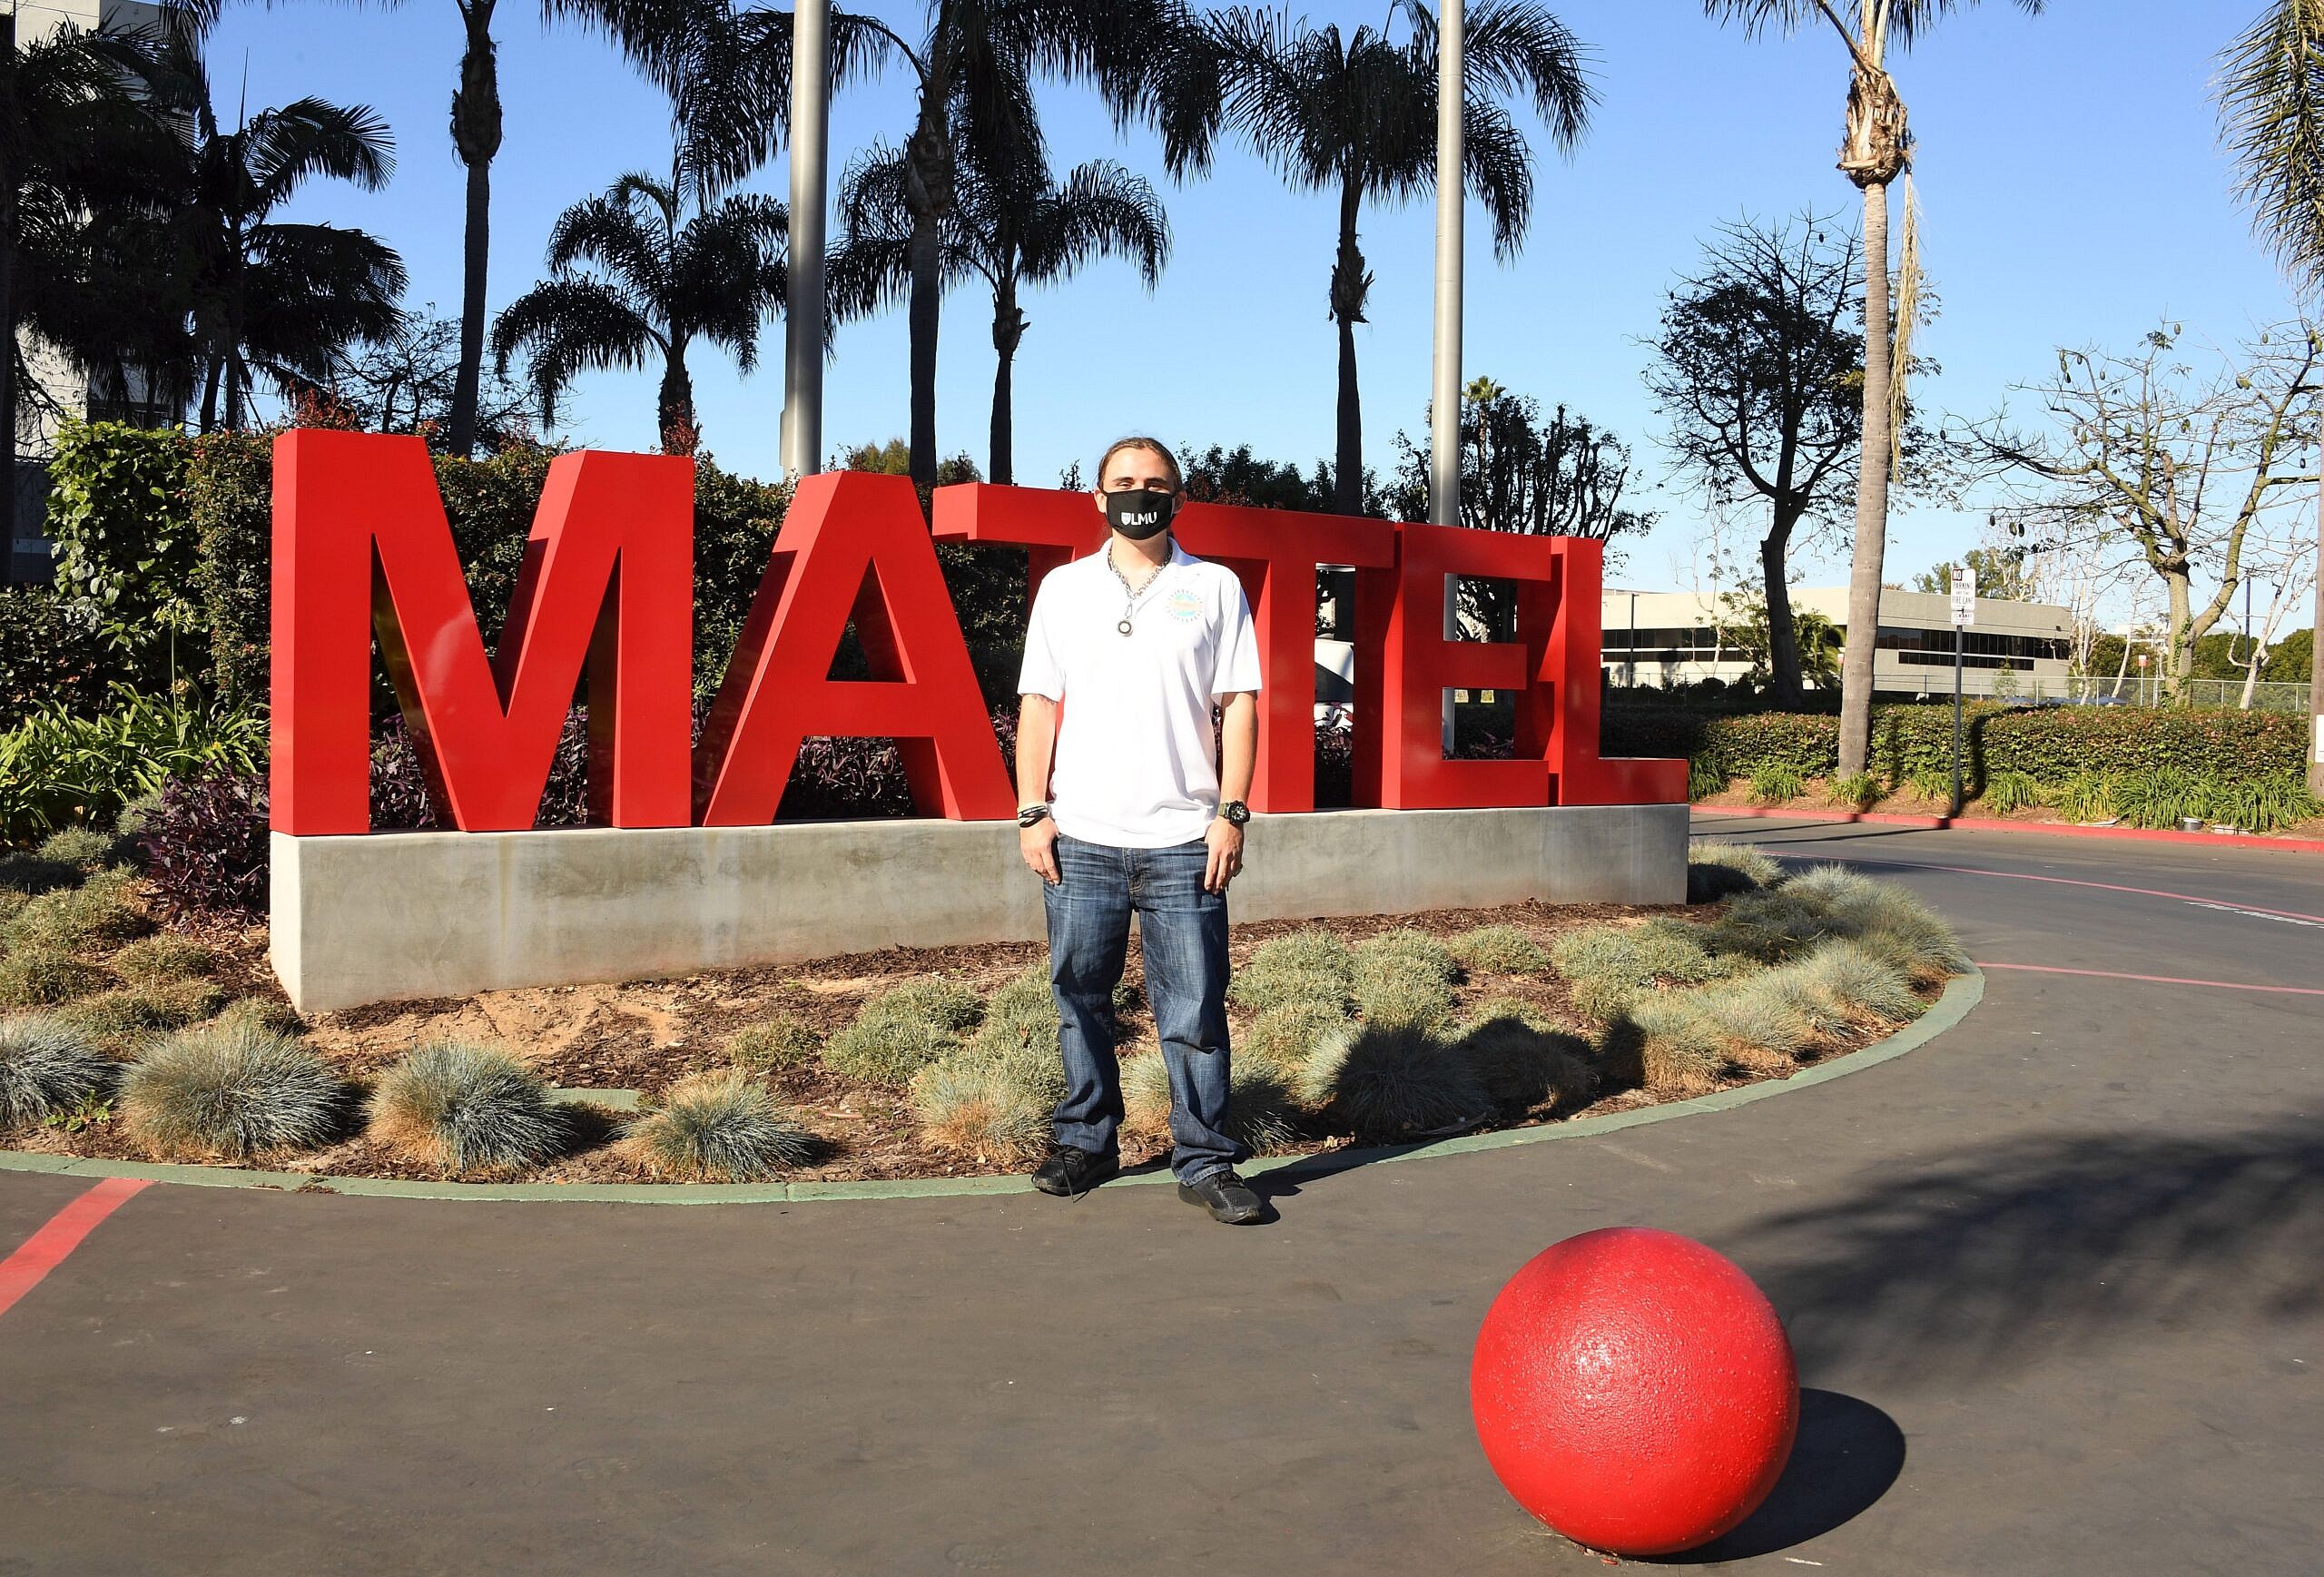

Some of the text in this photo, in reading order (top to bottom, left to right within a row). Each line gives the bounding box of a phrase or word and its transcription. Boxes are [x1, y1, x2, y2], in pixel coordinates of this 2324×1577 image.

[1131, 511, 1157, 525] LMU
[1953, 570, 1962, 579] NO
[1953, 582, 1974, 590] PARKING
